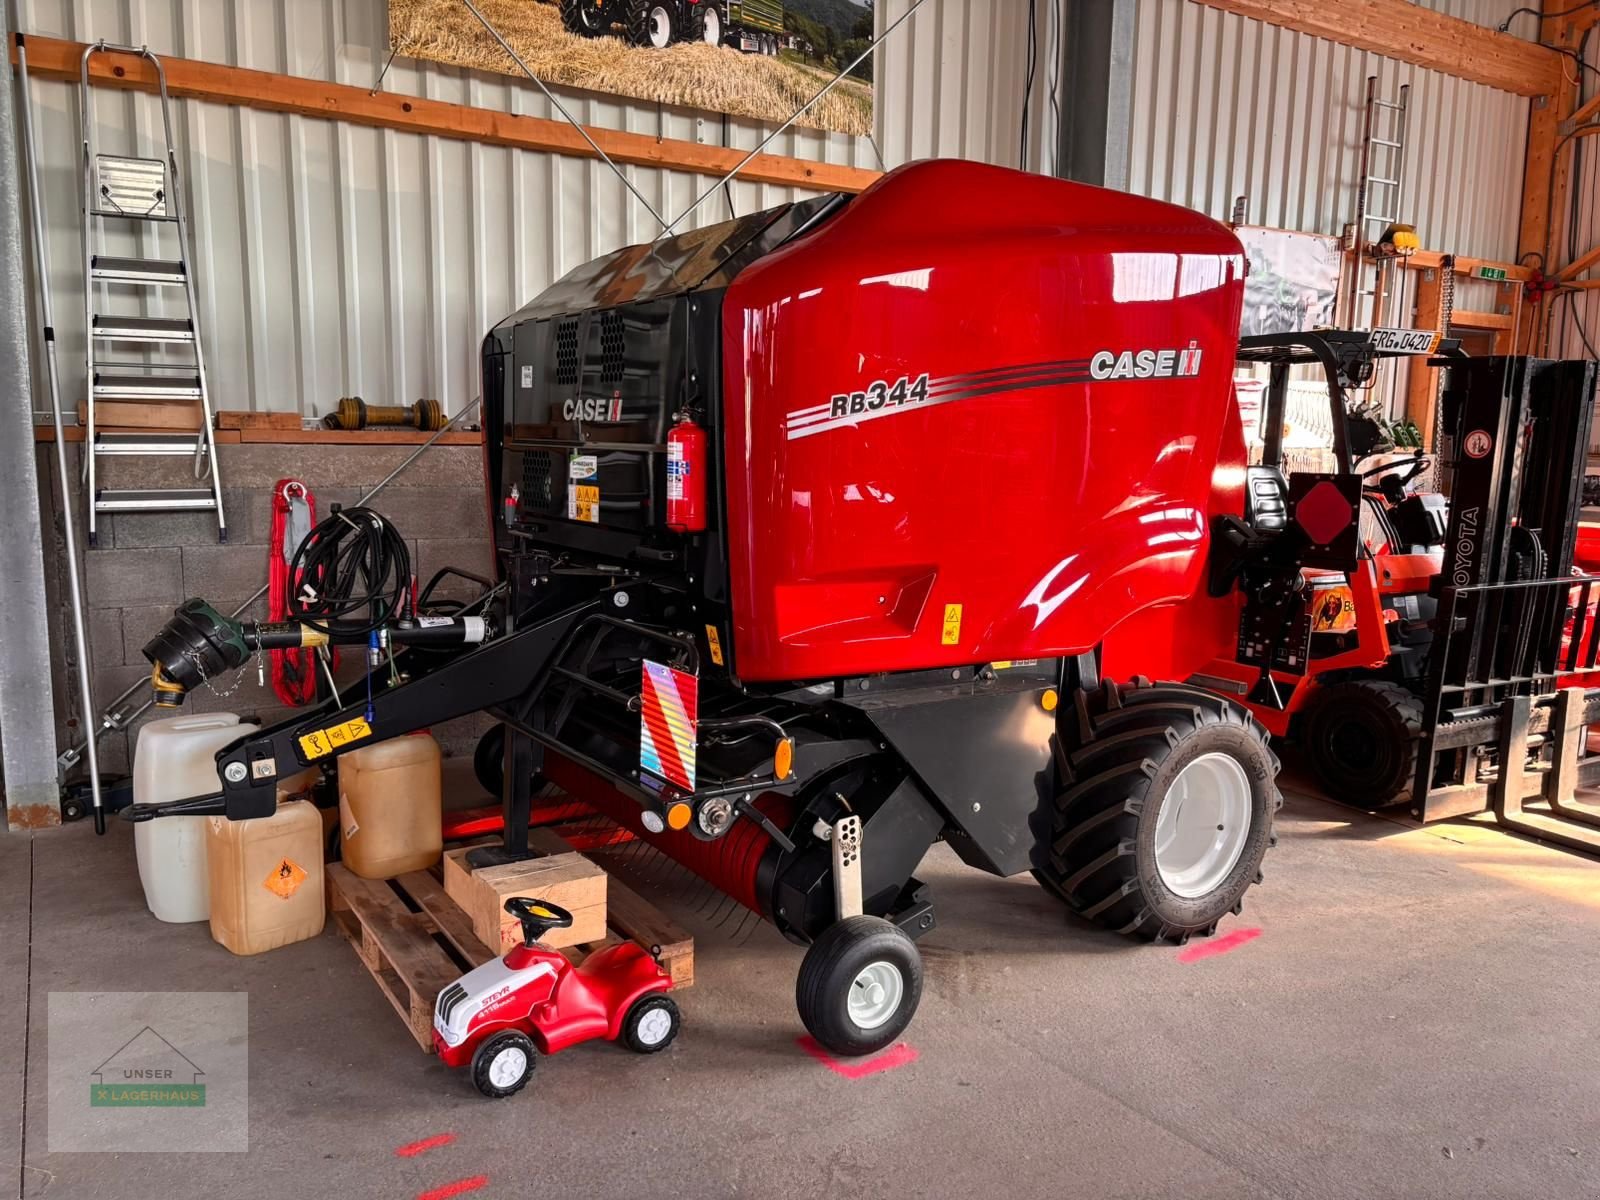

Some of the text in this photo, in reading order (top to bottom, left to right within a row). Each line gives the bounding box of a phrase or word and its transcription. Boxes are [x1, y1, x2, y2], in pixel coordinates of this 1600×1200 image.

[1090, 349, 1175, 380] CASE
[563, 398, 606, 421] CASE
[830, 373, 930, 419] RB344
[481, 985, 510, 1007] STEYR
